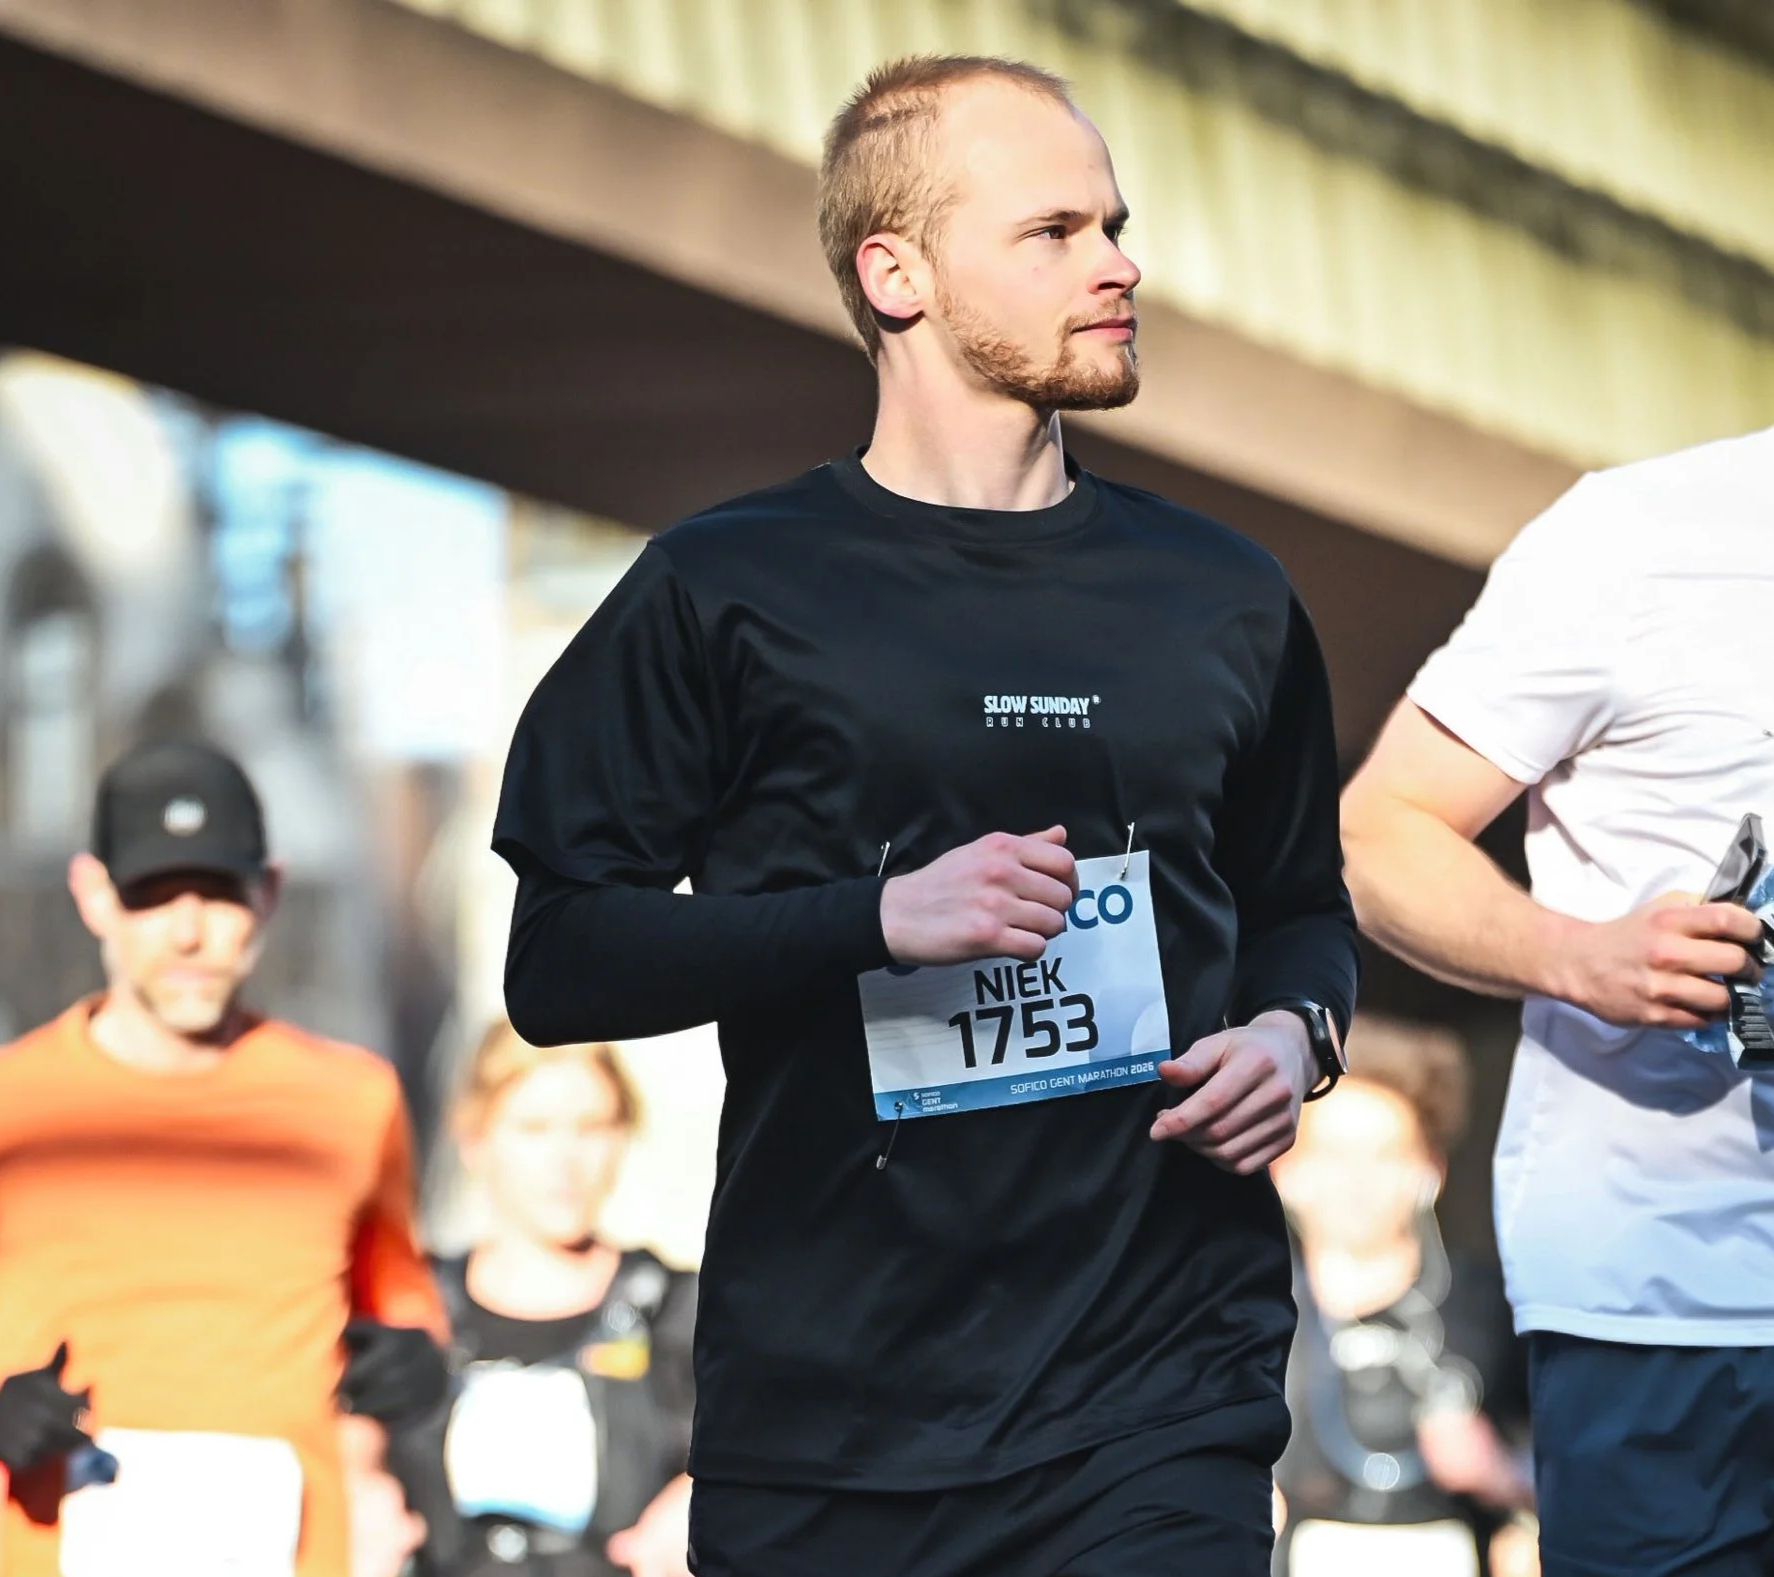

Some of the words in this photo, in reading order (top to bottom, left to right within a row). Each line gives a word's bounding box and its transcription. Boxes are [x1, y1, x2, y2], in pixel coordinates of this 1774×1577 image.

[983, 695, 1028, 714] SLOW
[986, 717, 1024, 728] RUN
[1041, 717, 1091, 729] CLUB
[973, 956, 1067, 1005] NIEK
[948, 993, 1099, 1069] 1753
[1009, 1080, 1048, 1096] SOFICO
[1049, 1075, 1076, 1089] GENT
[1077, 1066, 1129, 1085] MARATHON
[1130, 1061, 1155, 1076] 2026
[921, 1097, 942, 1106] GENT
